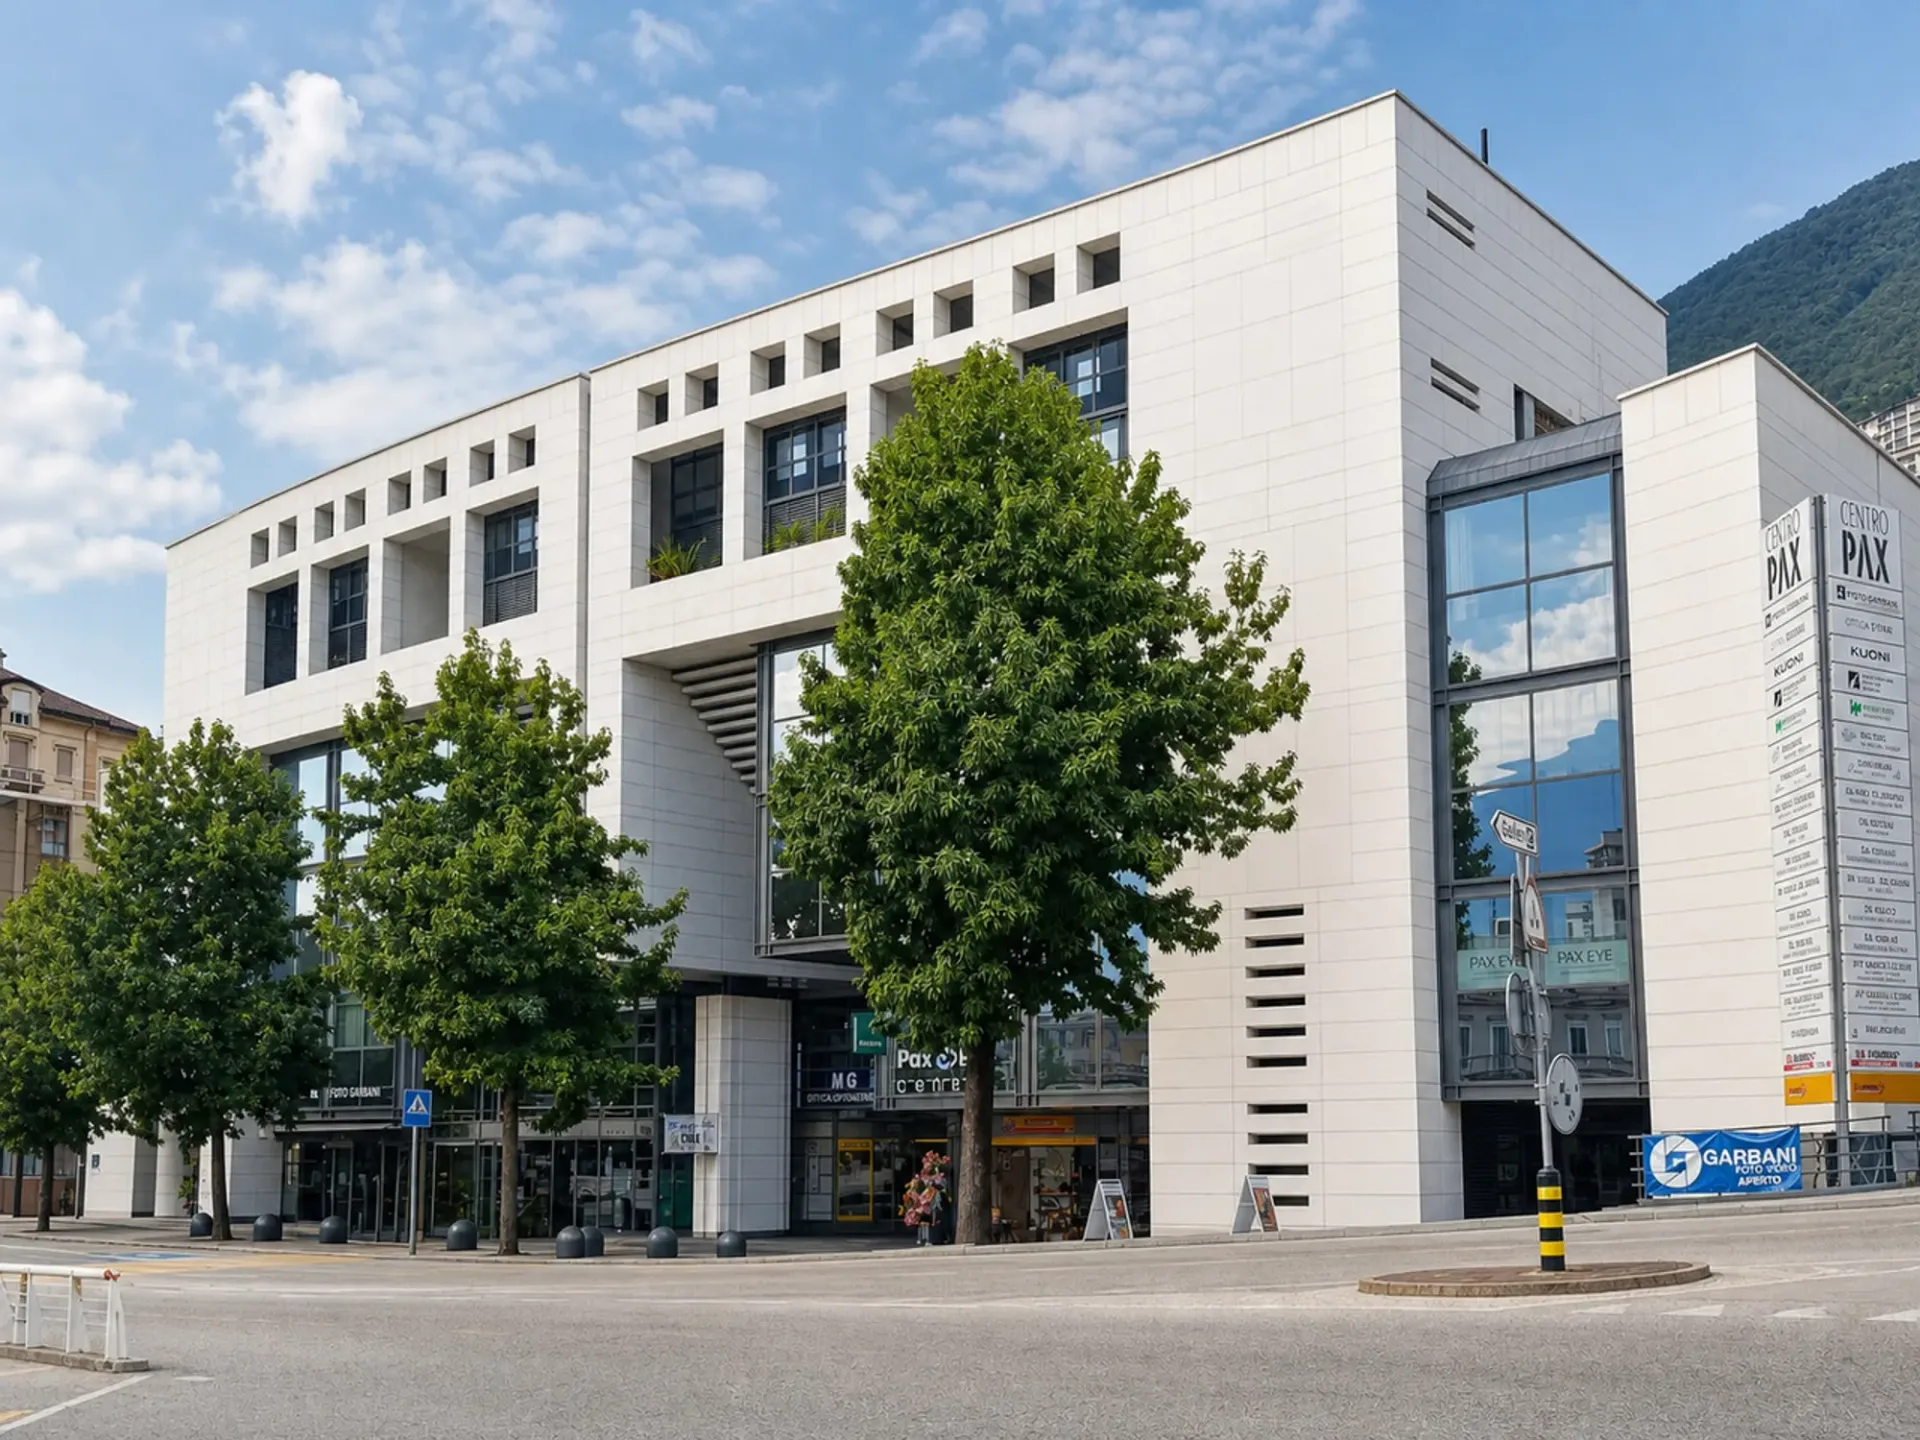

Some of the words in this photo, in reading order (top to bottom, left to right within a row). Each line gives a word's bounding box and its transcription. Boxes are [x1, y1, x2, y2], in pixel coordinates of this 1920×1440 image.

[1840, 501, 1889, 535] CENTRO
[1765, 508, 1801, 553] CENTRO
[1842, 529, 1890, 584] PAX
[1767, 536, 1802, 601] PAX
[1850, 646, 1891, 662] KUONI
[1773, 652, 1804, 678] KUONI
[1469, 956, 1496, 969] PAX
[1557, 949, 1583, 964] PAX
[1587, 948, 1613, 962] EYE
[897, 1049, 932, 1069] Pax
[329, 1086, 349, 1099] FOTO
[1703, 1147, 1797, 1166] GARBANI
[1735, 1165, 1763, 1174] FOTO
[1738, 1175, 1782, 1187] APERTO
